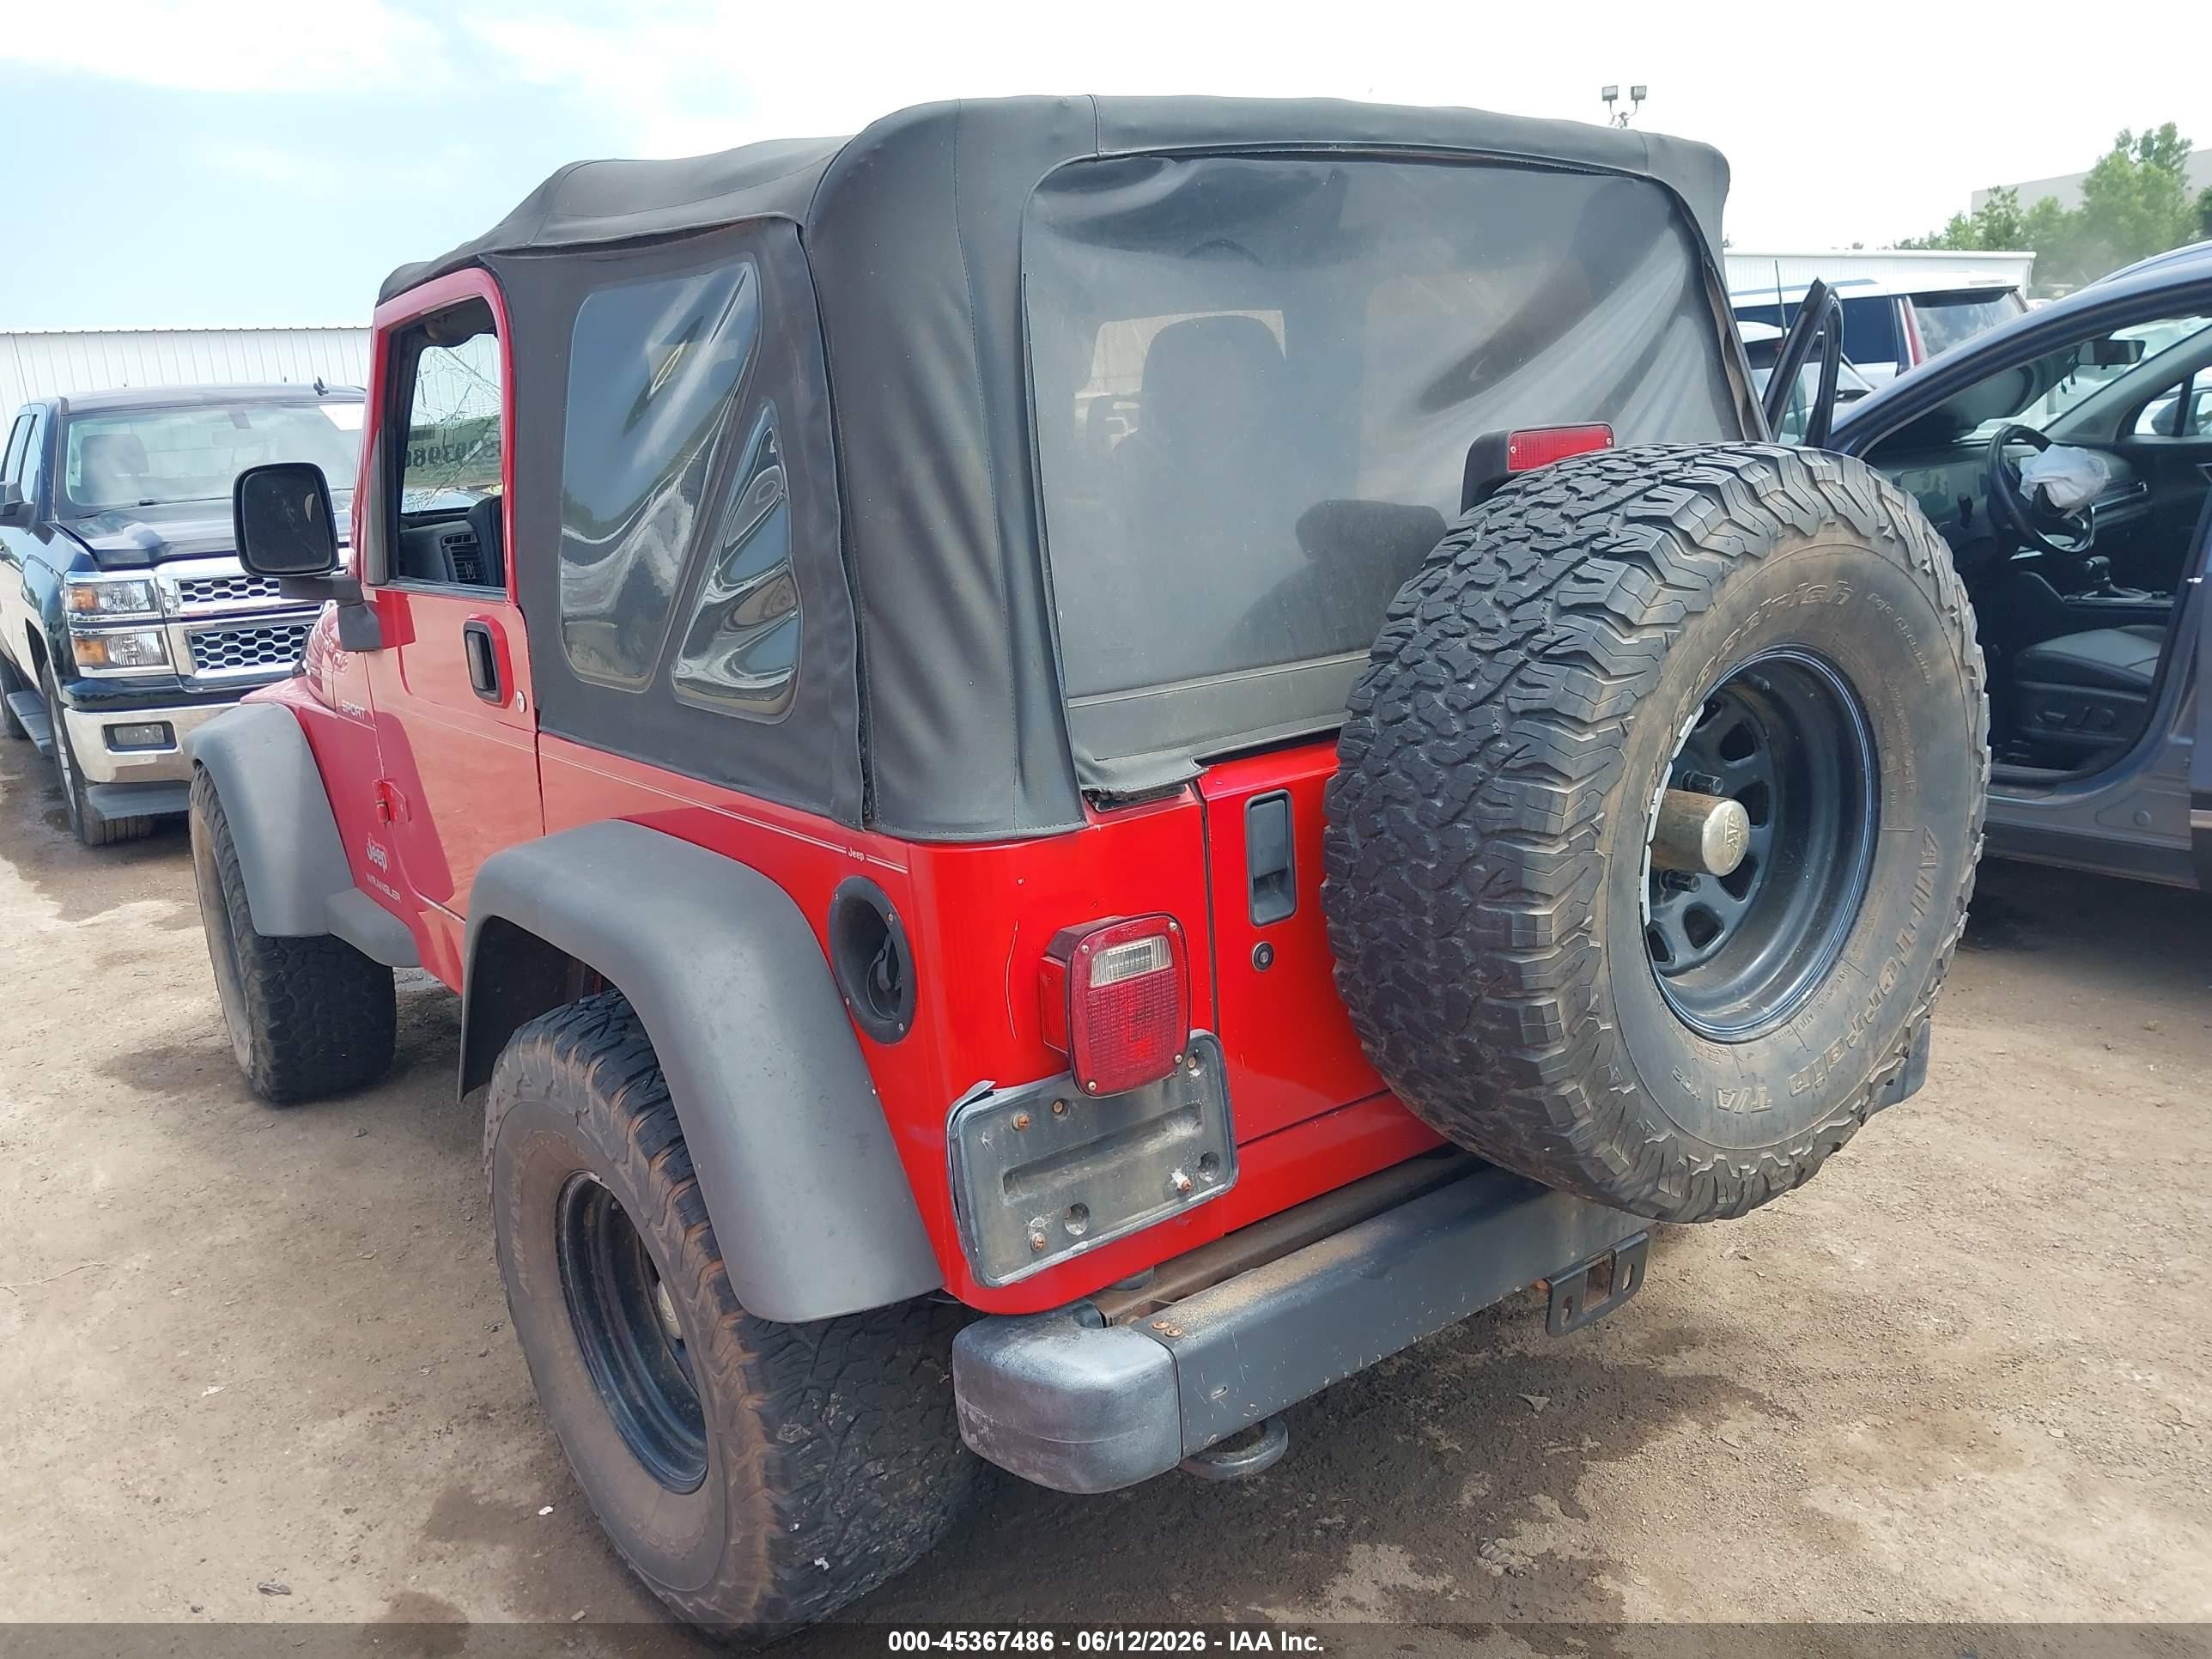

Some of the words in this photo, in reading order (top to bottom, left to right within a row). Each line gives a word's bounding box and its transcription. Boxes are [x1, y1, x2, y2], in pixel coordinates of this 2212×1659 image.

[342, 699, 366, 720] SPORT
[366, 836, 389, 873] Jeep
[848, 847, 865, 862] Jeep
[365, 872, 402, 904] WRANGLER
[1717, 1085, 1773, 1114] T/A
